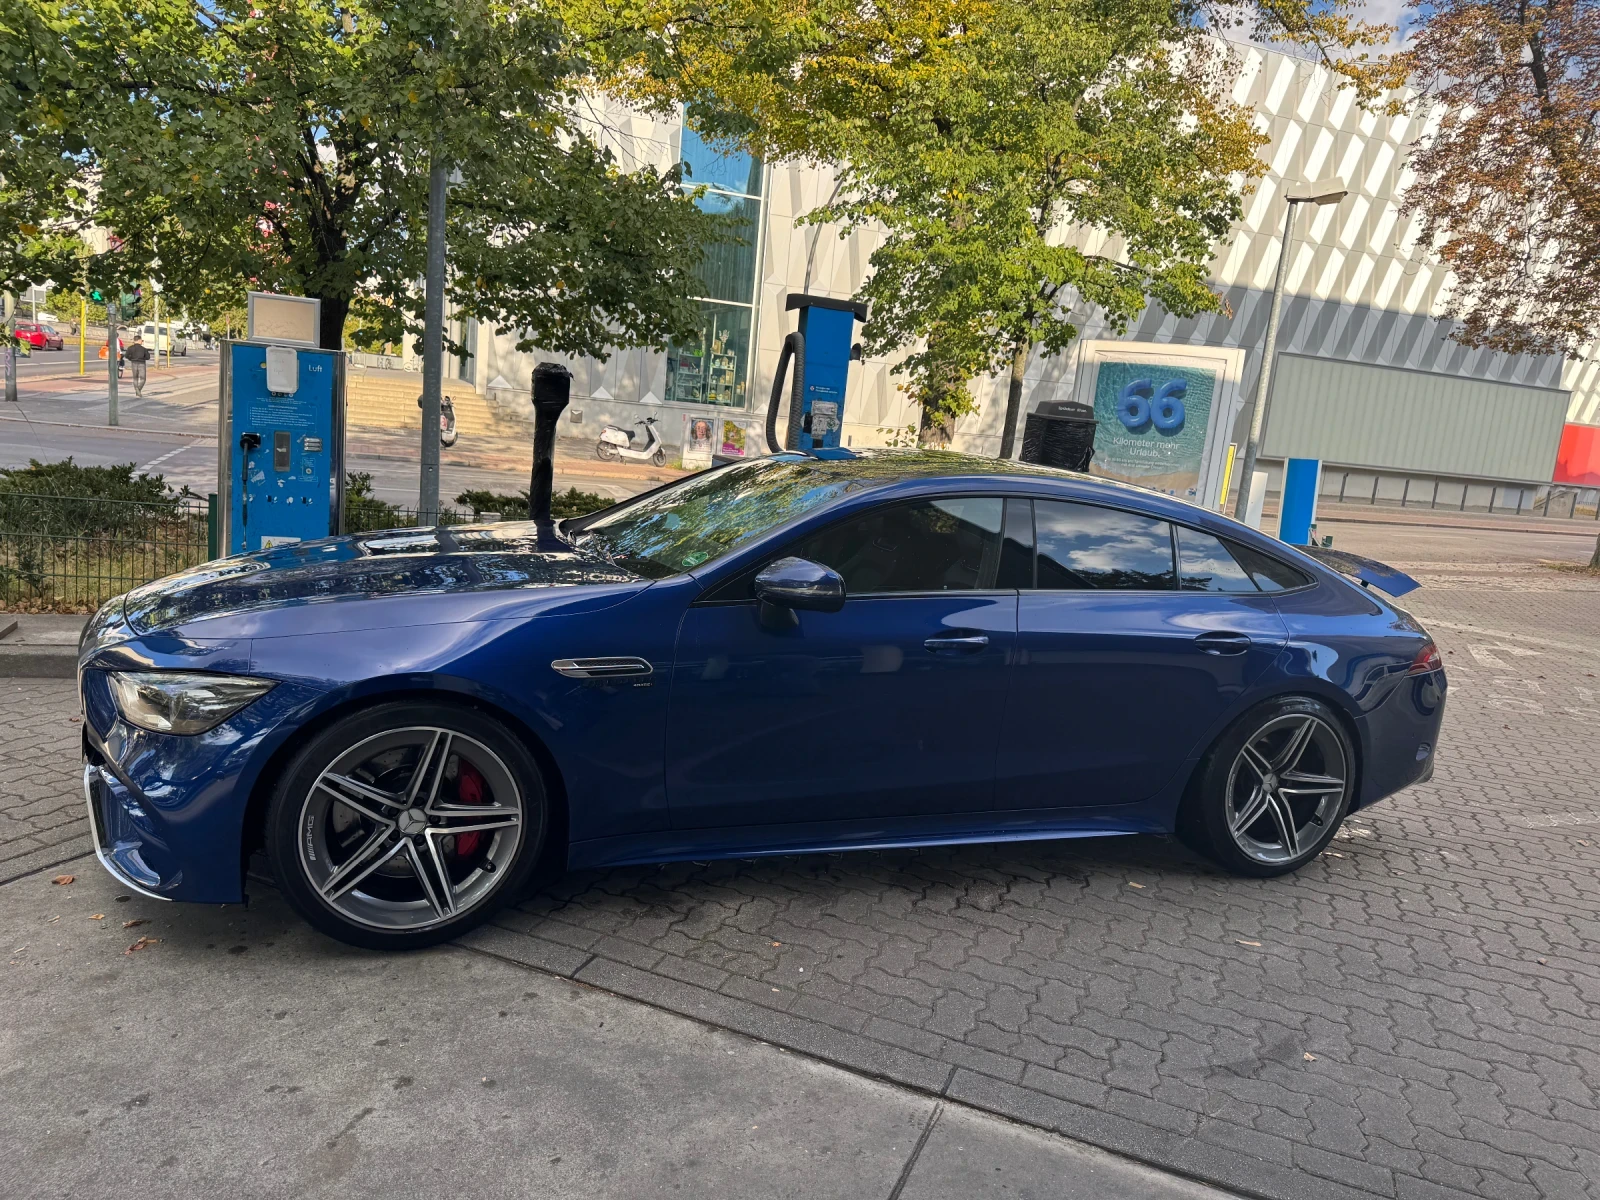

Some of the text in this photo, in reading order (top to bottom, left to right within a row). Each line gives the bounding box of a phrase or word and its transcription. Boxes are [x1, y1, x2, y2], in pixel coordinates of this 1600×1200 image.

[308, 364, 323, 373] Luft
[1117, 378, 1187, 429] 66
[1112, 437, 1180, 450] Kilometer mehr
